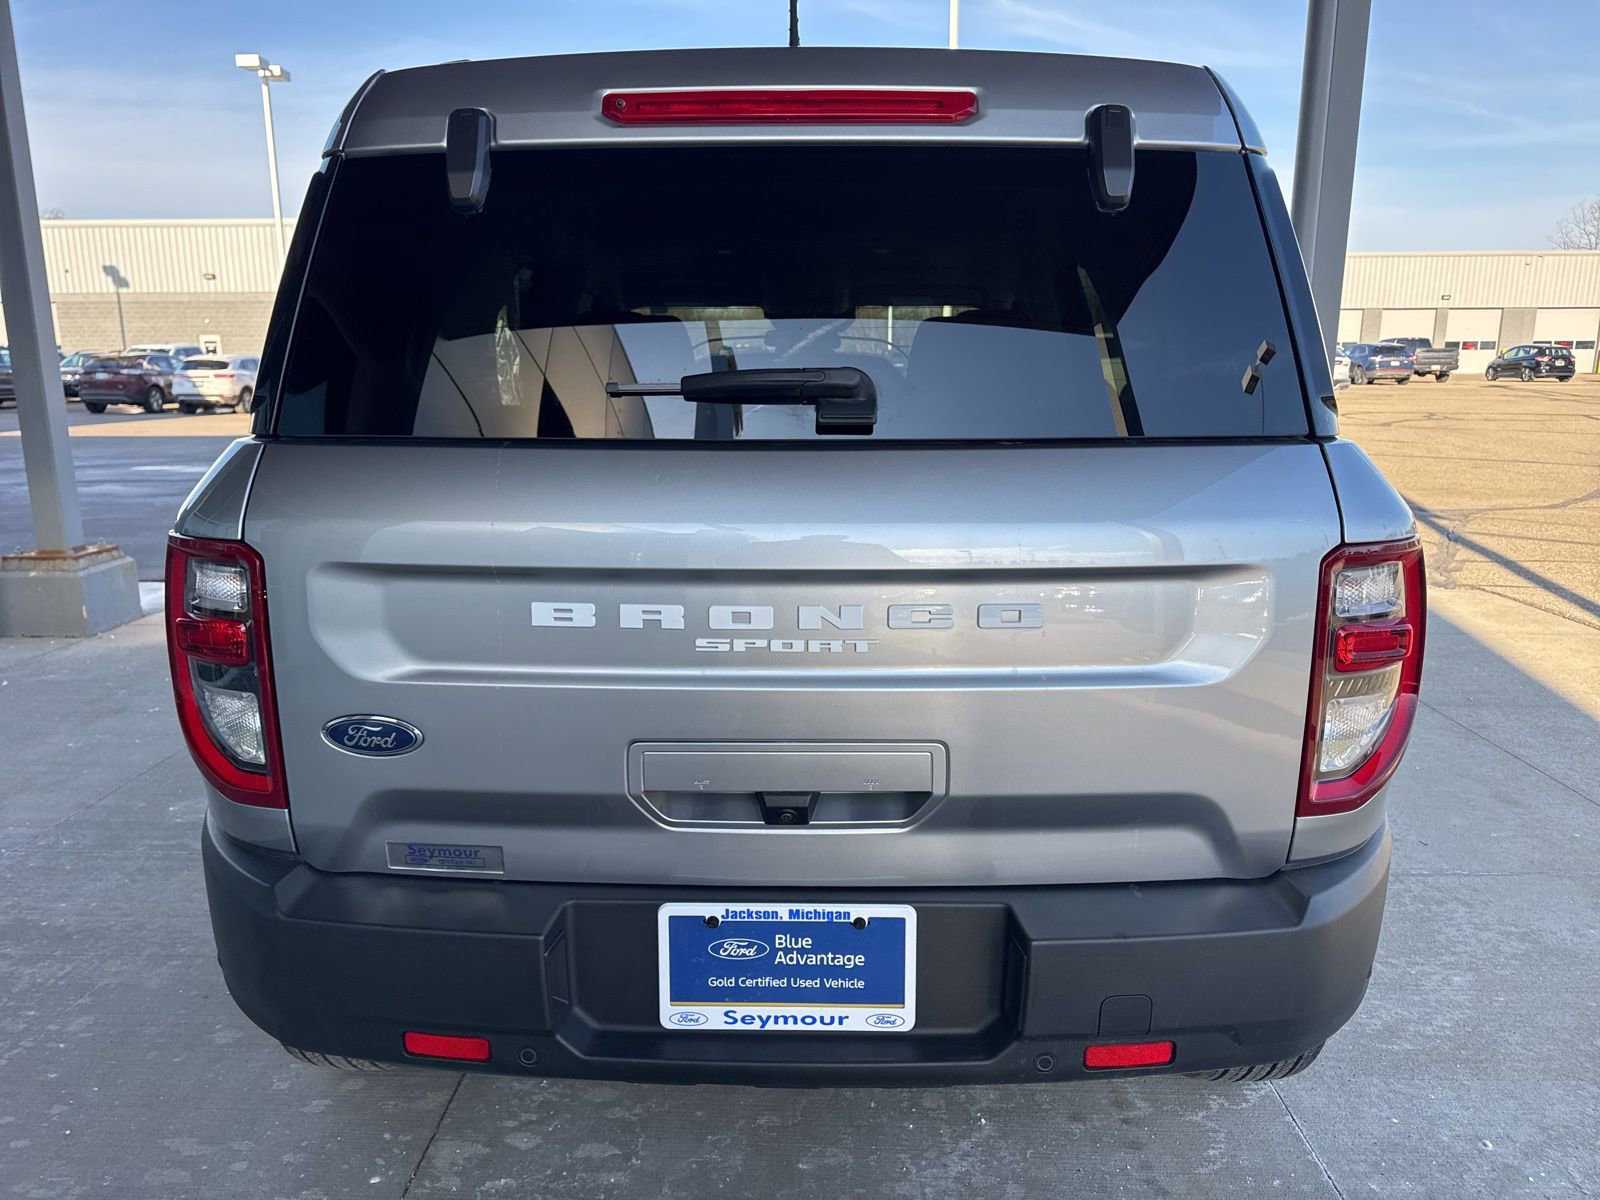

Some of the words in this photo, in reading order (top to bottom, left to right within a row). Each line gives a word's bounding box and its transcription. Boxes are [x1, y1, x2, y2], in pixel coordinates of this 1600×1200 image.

[530, 601, 1044, 629] BRONCO
[694, 638, 878, 653] SPORT
[343, 724, 397, 748] Ford
[407, 843, 480, 859] Seymour
[721, 909, 783, 920] Jackson,
[789, 909, 850, 921] Michigan
[719, 941, 757, 957] Ford
[774, 934, 812, 949] Blue
[774, 951, 865, 968] Advantage
[708, 977, 735, 987] Gold
[738, 977, 787, 988] Certified
[791, 977, 820, 988] Used
[823, 978, 865, 988] Vehicle
[677, 1013, 700, 1024] Ford
[724, 1010, 849, 1029] Seymour
[874, 1015, 897, 1026] Ford
